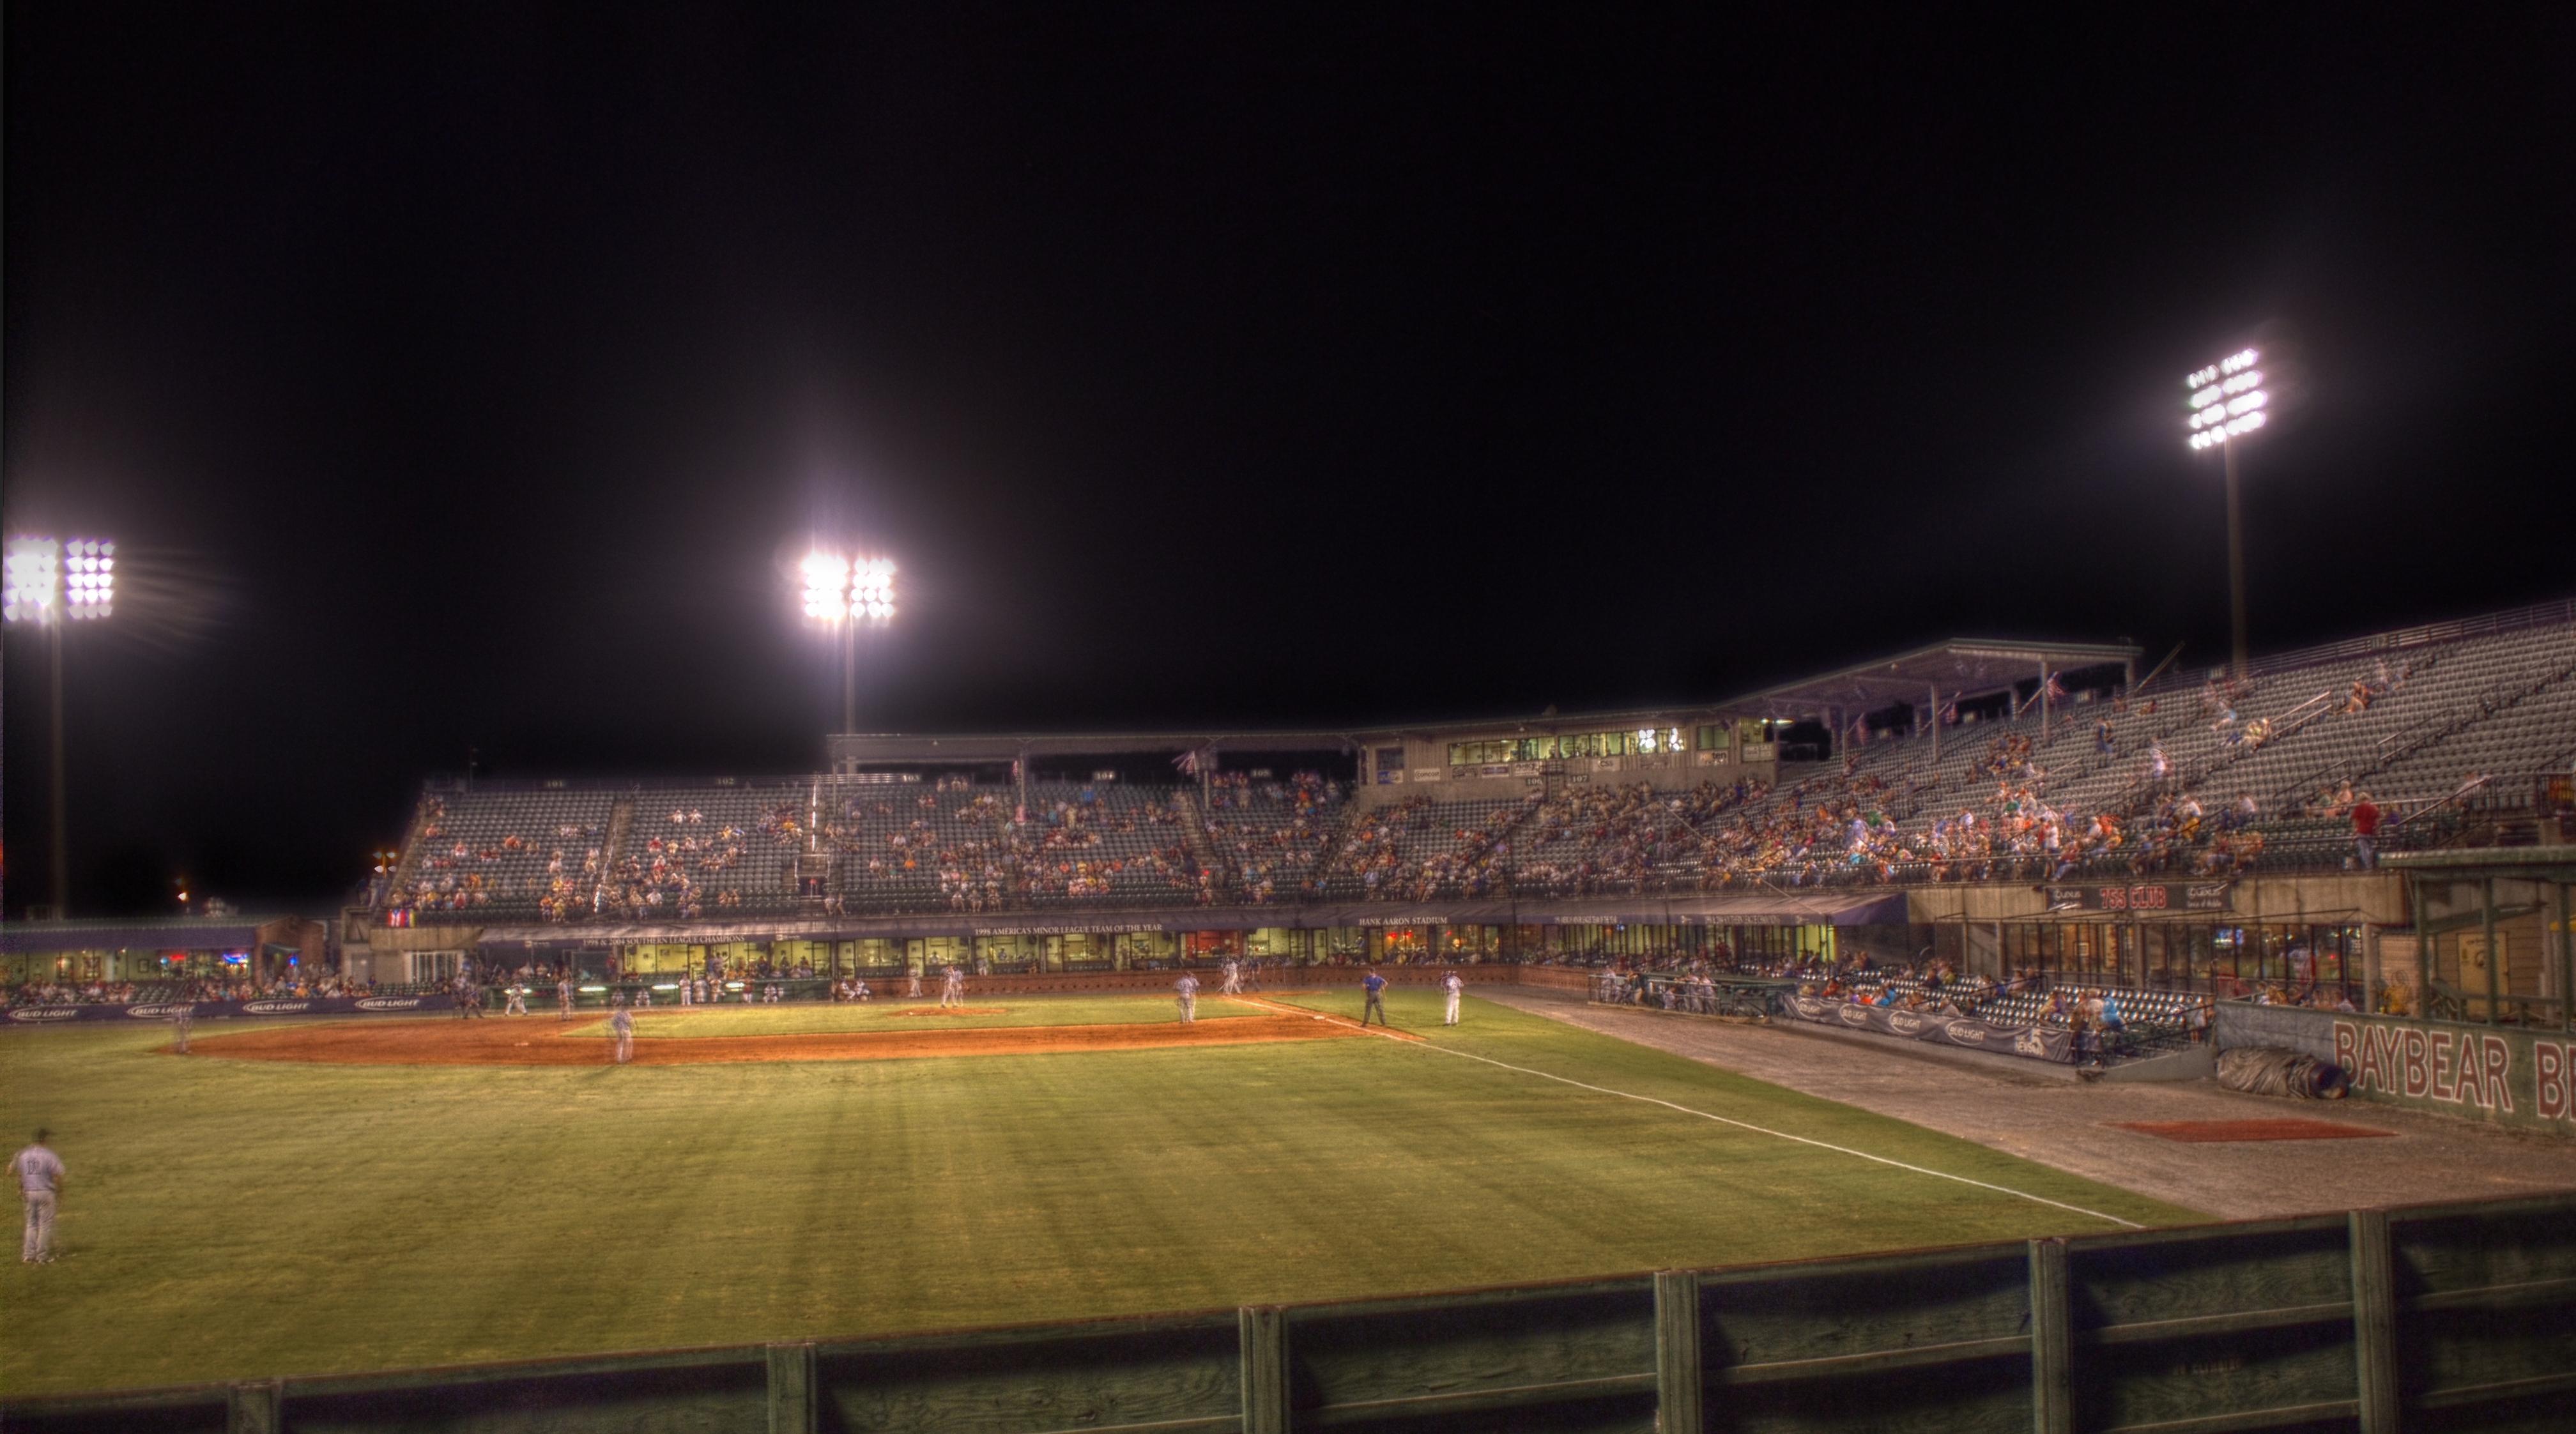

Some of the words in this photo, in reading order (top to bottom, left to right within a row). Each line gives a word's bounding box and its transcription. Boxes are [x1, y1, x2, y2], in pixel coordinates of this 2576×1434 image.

[1572, 775, 1588, 783] 107
[2099, 888, 2127, 909] 755
[2129, 885, 2167, 908] CLUB
[1411, 916, 1448, 924] STADIUM
[992, 927, 1032, 935] AMERICA'S
[1032, 926, 1059, 934] MINOR
[625, 937, 668, 945] SOUTHERN
[671, 935, 699, 943] LEAGUE
[700, 934, 745, 943] CHAMPIONS
[1842, 1009, 1852, 1018] BUD
[1853, 1011, 1867, 1021] LIGHT
[1892, 1016, 1904, 1026] BUD
[1904, 1018, 1921, 1028] LIGHT
[1949, 1026, 1963, 1036] BUD
[1964, 1028, 1985, 1041] LIGHT
[2333, 1021, 2515, 1113] BAYBEAR
